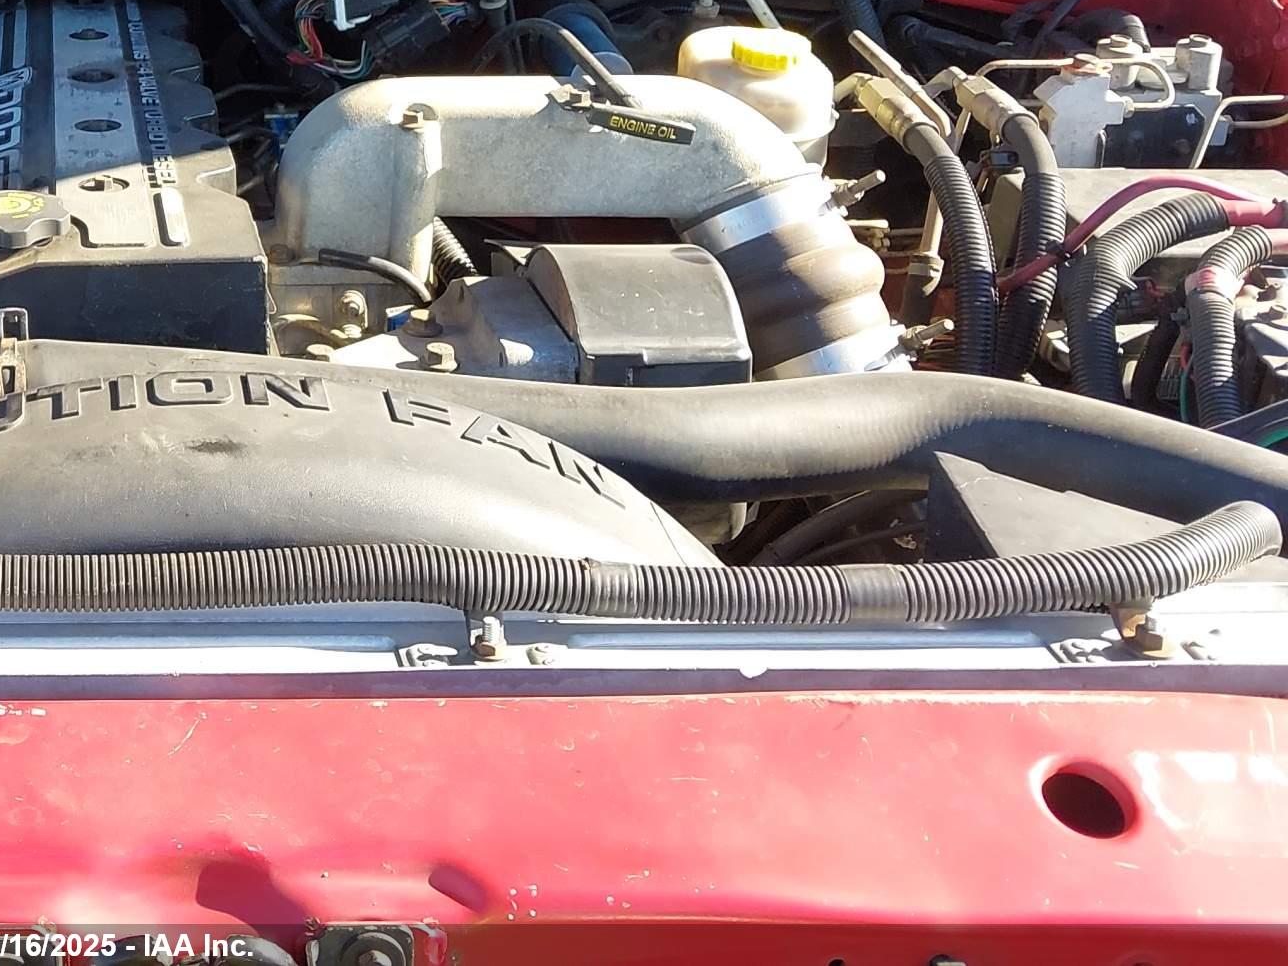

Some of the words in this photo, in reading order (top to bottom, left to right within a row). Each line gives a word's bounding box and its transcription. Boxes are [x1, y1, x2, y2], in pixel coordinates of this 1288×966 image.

[610, 116, 657, 136] ENGINE
[657, 126, 677, 140] OIL
[381, 387, 626, 510] FAN
